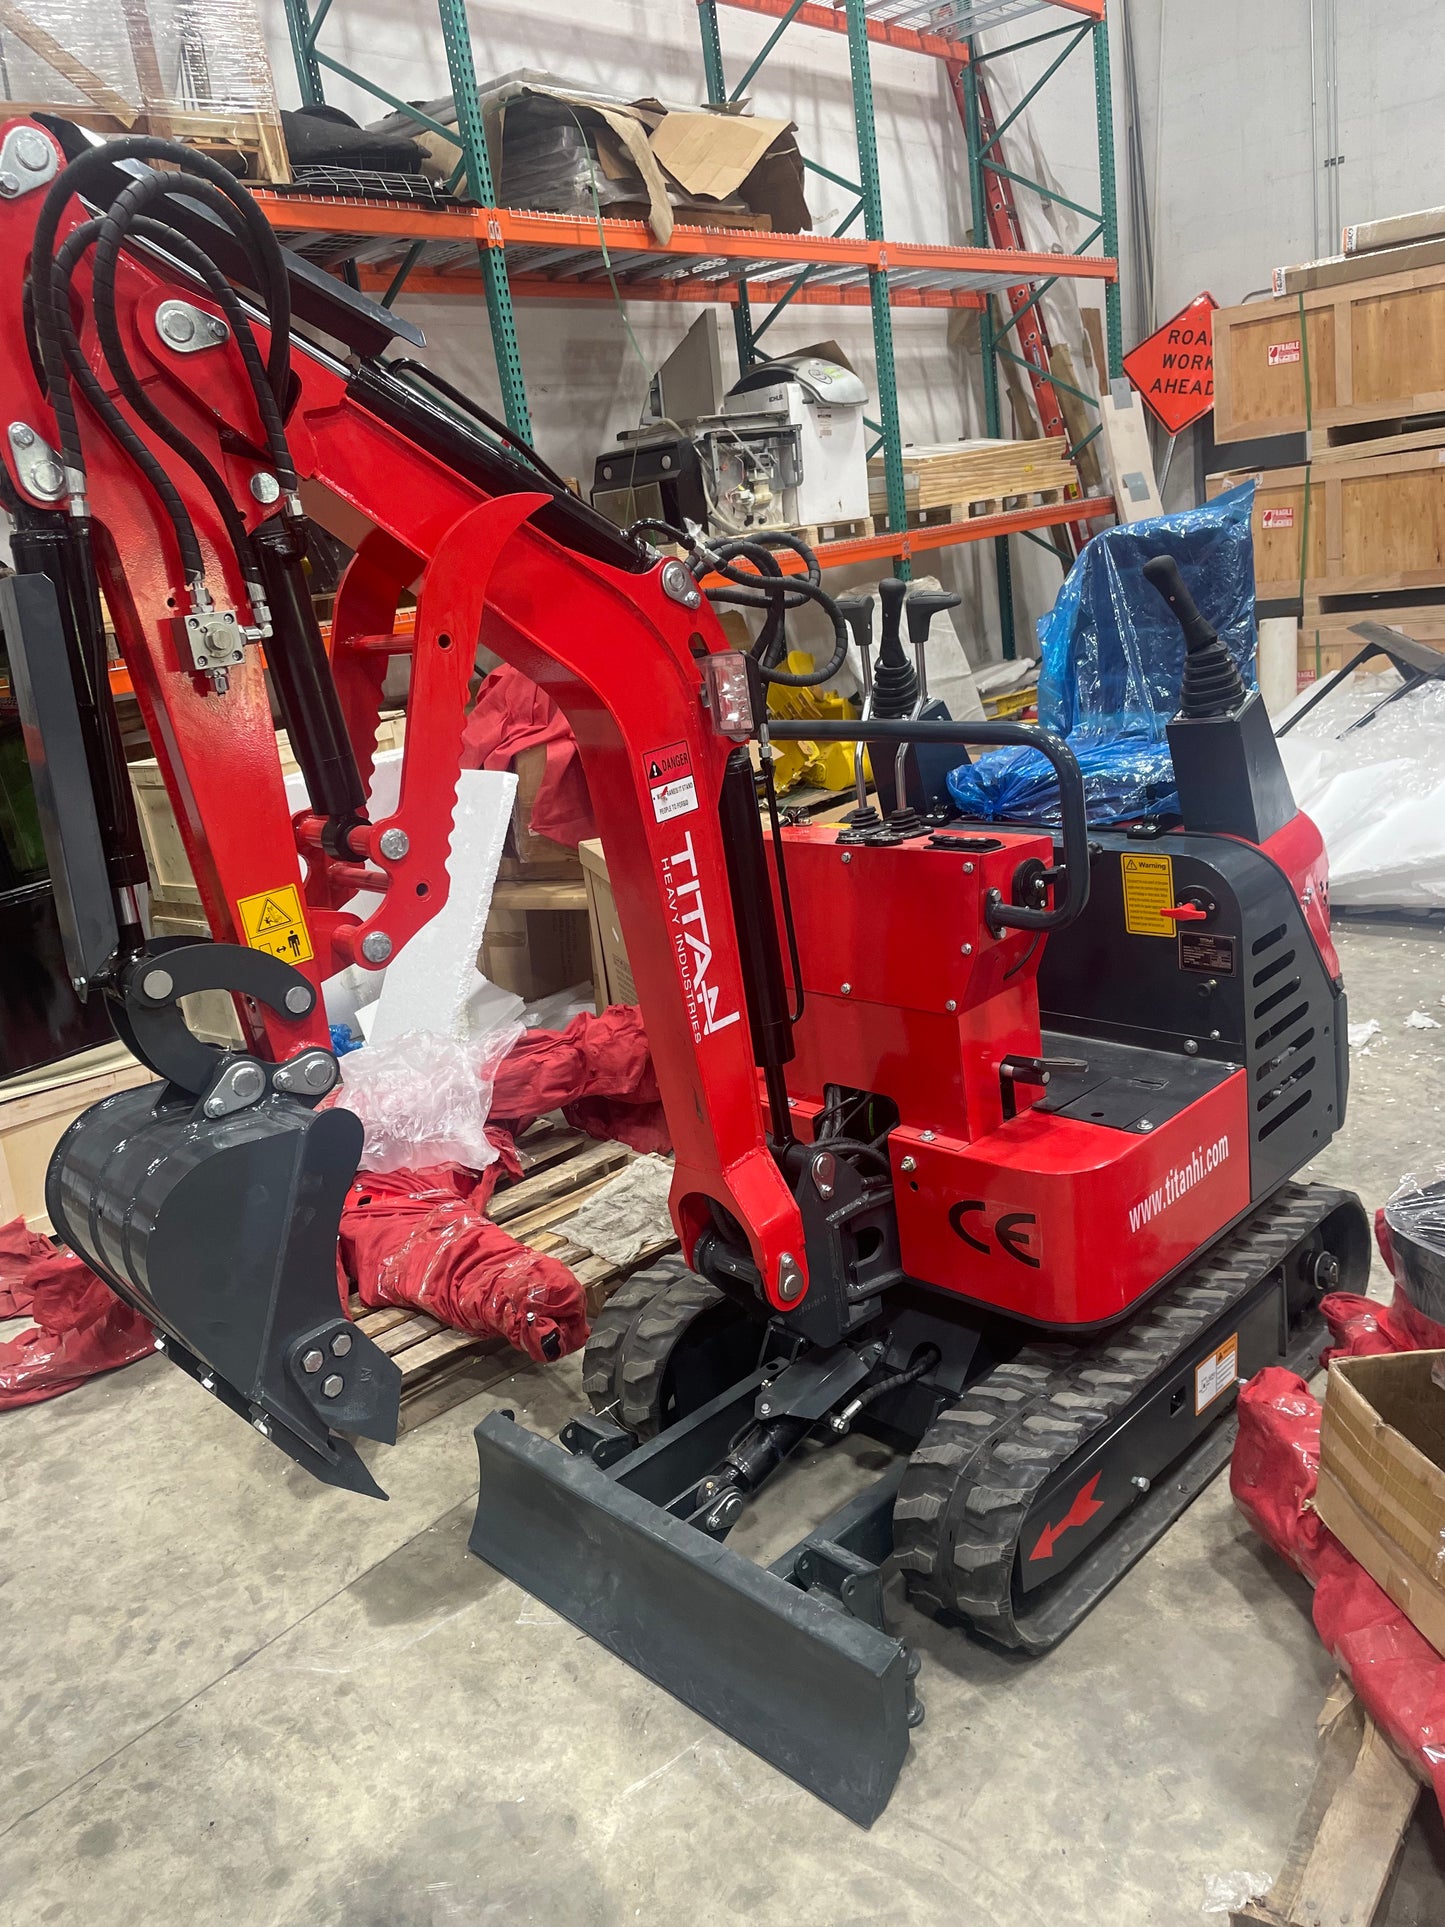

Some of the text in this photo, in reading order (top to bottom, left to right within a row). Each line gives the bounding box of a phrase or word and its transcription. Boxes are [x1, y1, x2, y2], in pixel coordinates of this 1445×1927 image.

[1168, 329, 1212, 345] ROA
[1278, 341, 1299, 350] FRAGILE
[1162, 354, 1213, 370] WORK
[1150, 378, 1214, 395] AHEAD
[662, 752, 689, 771] DANGER
[1139, 861, 1167, 870] Warning
[670, 831, 740, 1035] TITAN
[661, 857, 702, 1044] HEAVY INDUSTRIES
[1129, 1135, 1229, 1233] www.titanhi.com
[948, 1200, 1041, 1269] CE
